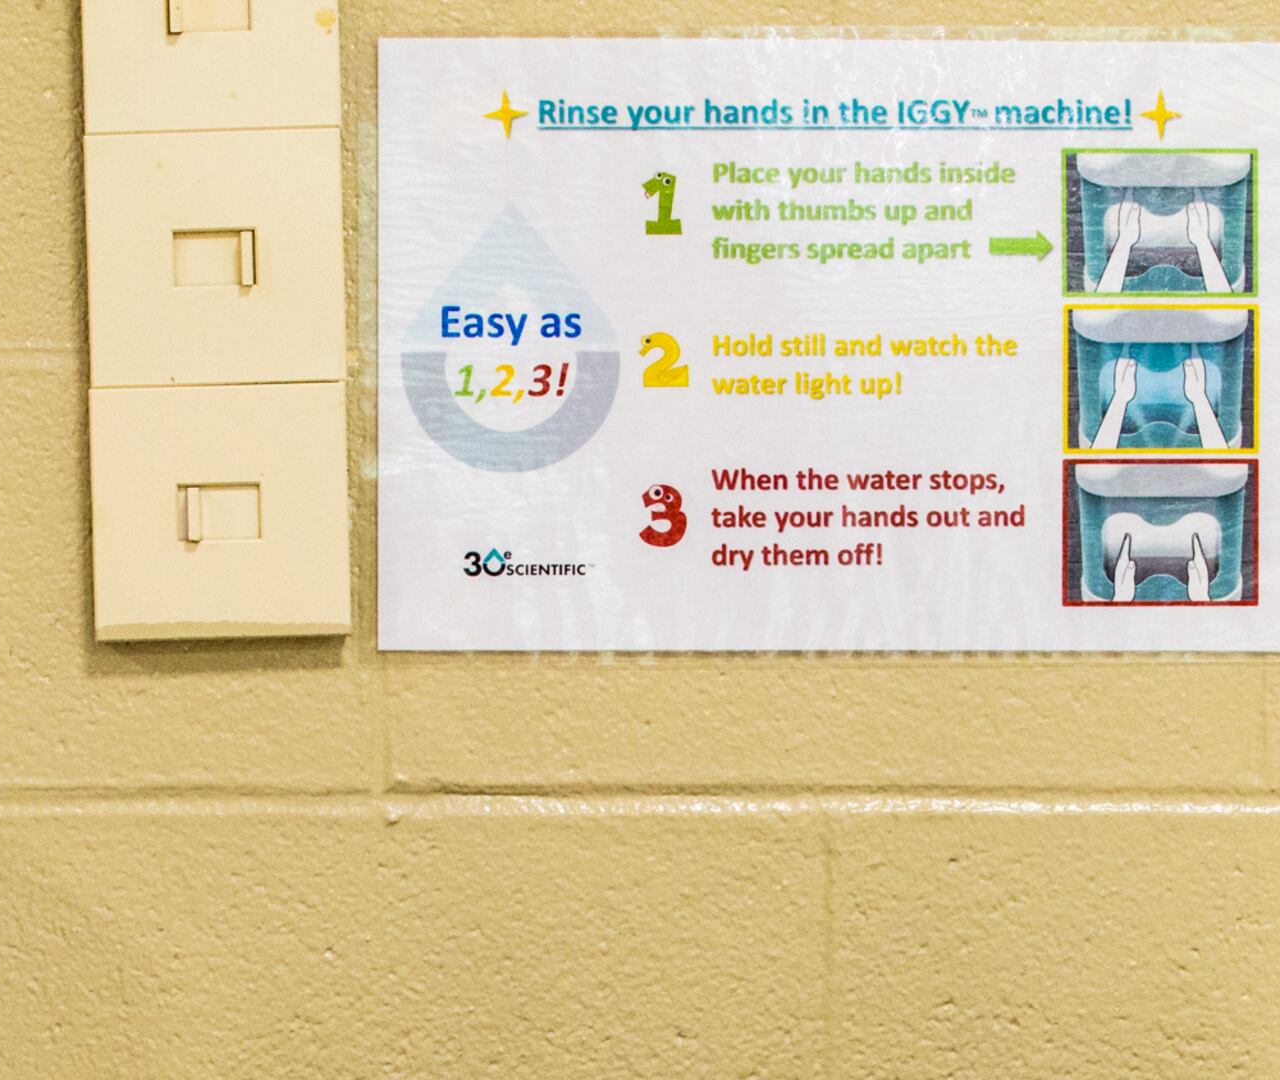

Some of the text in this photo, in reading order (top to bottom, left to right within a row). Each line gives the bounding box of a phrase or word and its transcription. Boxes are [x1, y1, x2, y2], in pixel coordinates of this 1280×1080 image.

[538, 99, 618, 125] Rinse
[628, 102, 696, 131] your
[704, 98, 793, 125] hands
[802, 99, 829, 125] in
[839, 98, 888, 125] the
[995, 98, 1133, 125] machine!
[712, 161, 1016, 189] Place your hands inside
[641, 171, 683, 235] 1
[712, 199, 973, 226] with thumbs up and
[712, 236, 972, 265] fingers spread apart
[441, 305, 582, 346] Easy as
[712, 333, 1018, 356] Hold still and watch the
[638, 332, 689, 387] 2
[454, 362, 569, 404] 1,2,3!
[712, 371, 902, 400] water light up!
[711, 468, 1005, 494] When the water stops,
[639, 484, 687, 548] 3
[711, 505, 1025, 532] take your hands out and
[711, 544, 883, 571] dry them off!
